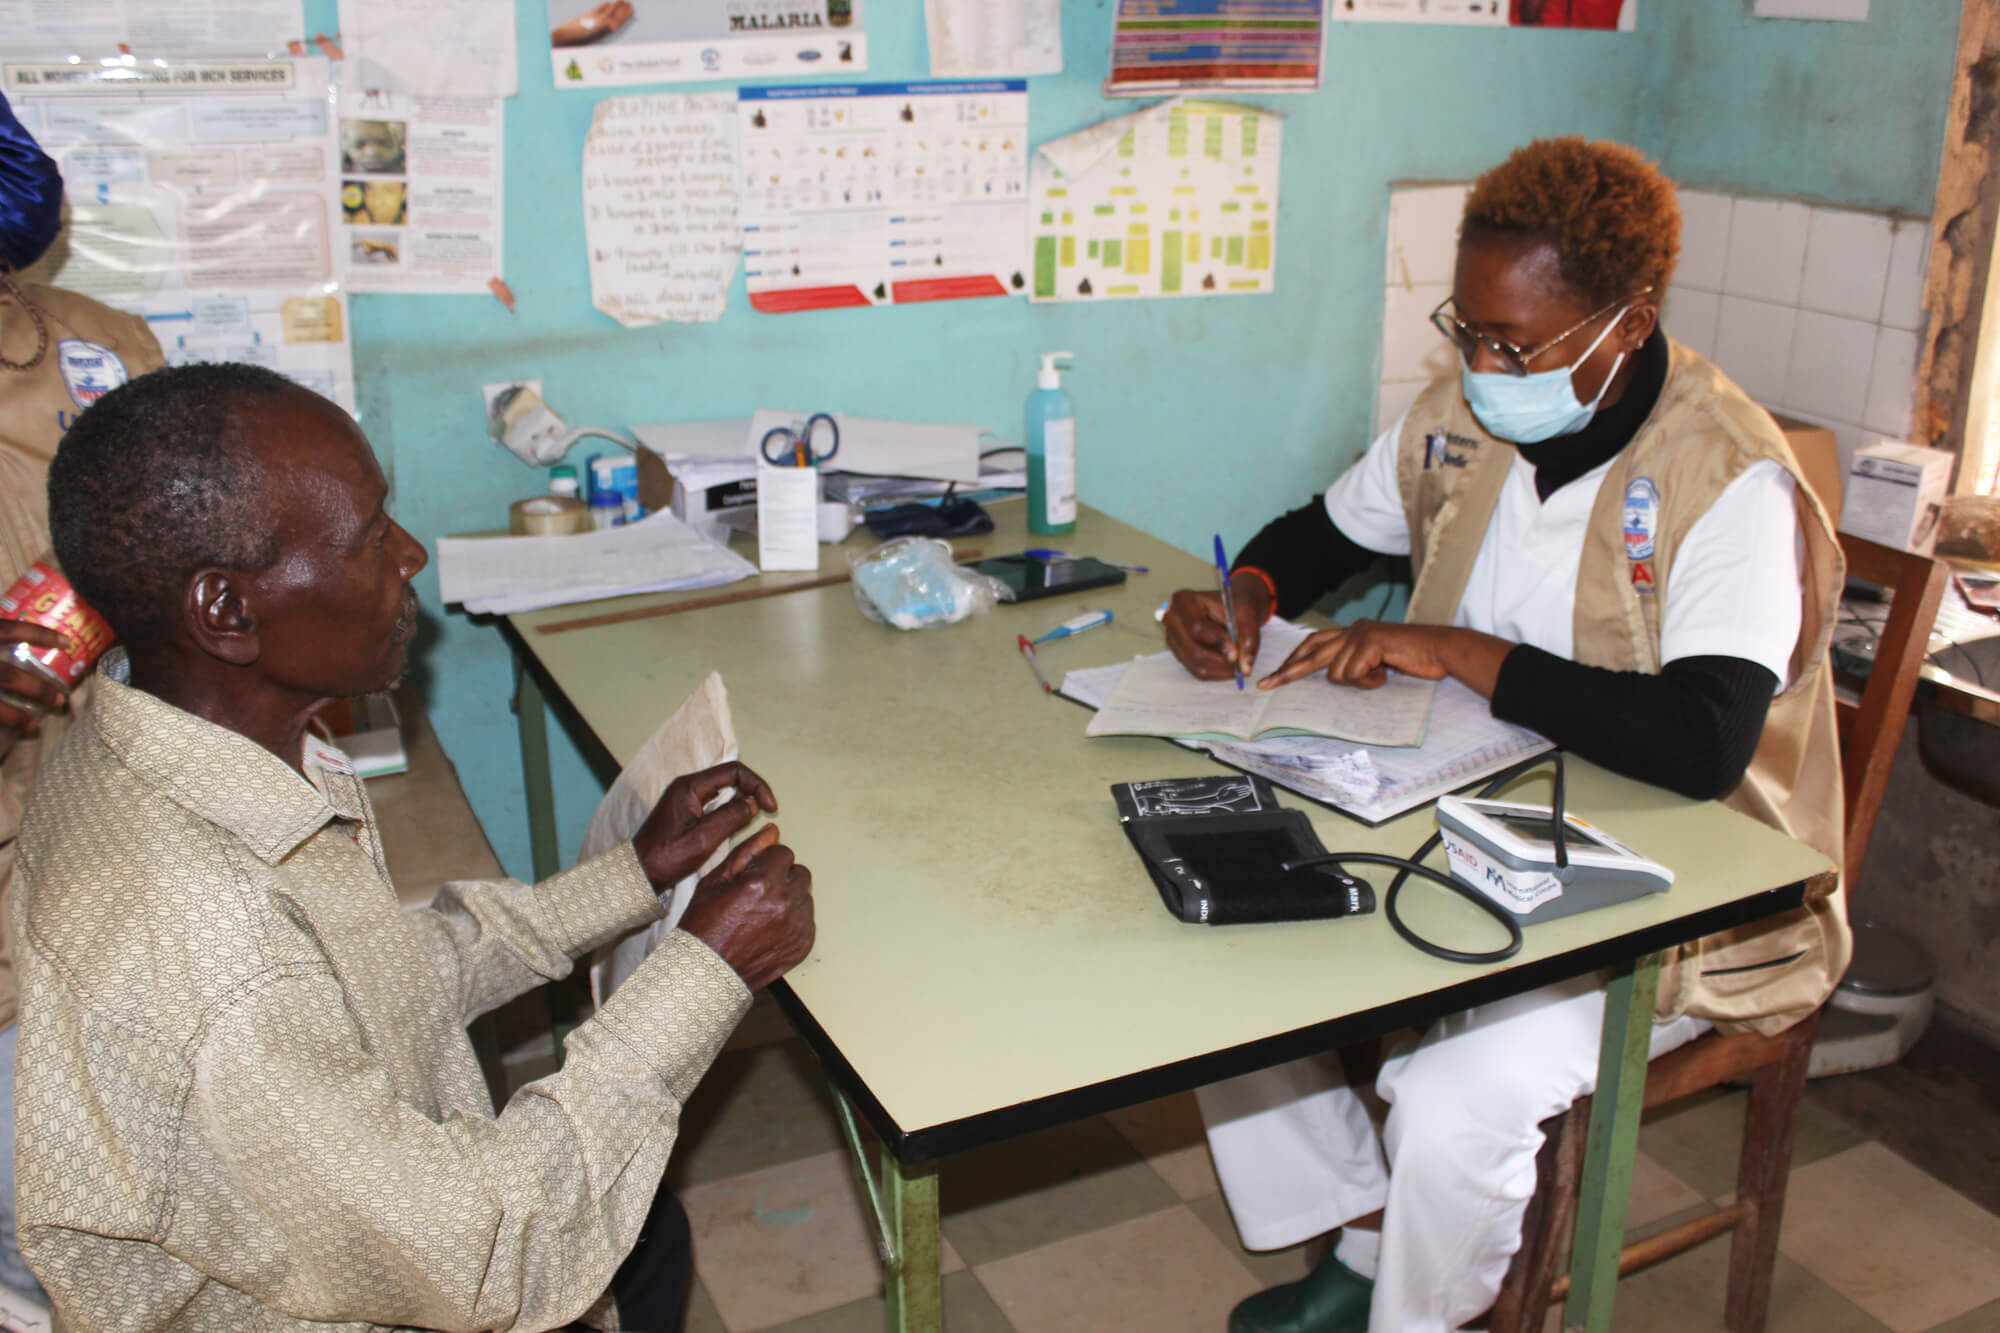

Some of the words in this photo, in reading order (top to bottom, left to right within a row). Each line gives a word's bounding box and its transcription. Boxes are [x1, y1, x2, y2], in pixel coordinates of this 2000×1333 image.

[729, 12, 822, 31] MALARIA
[17, 71, 39, 84] ALL
[229, 70, 286, 83] SERVICES
